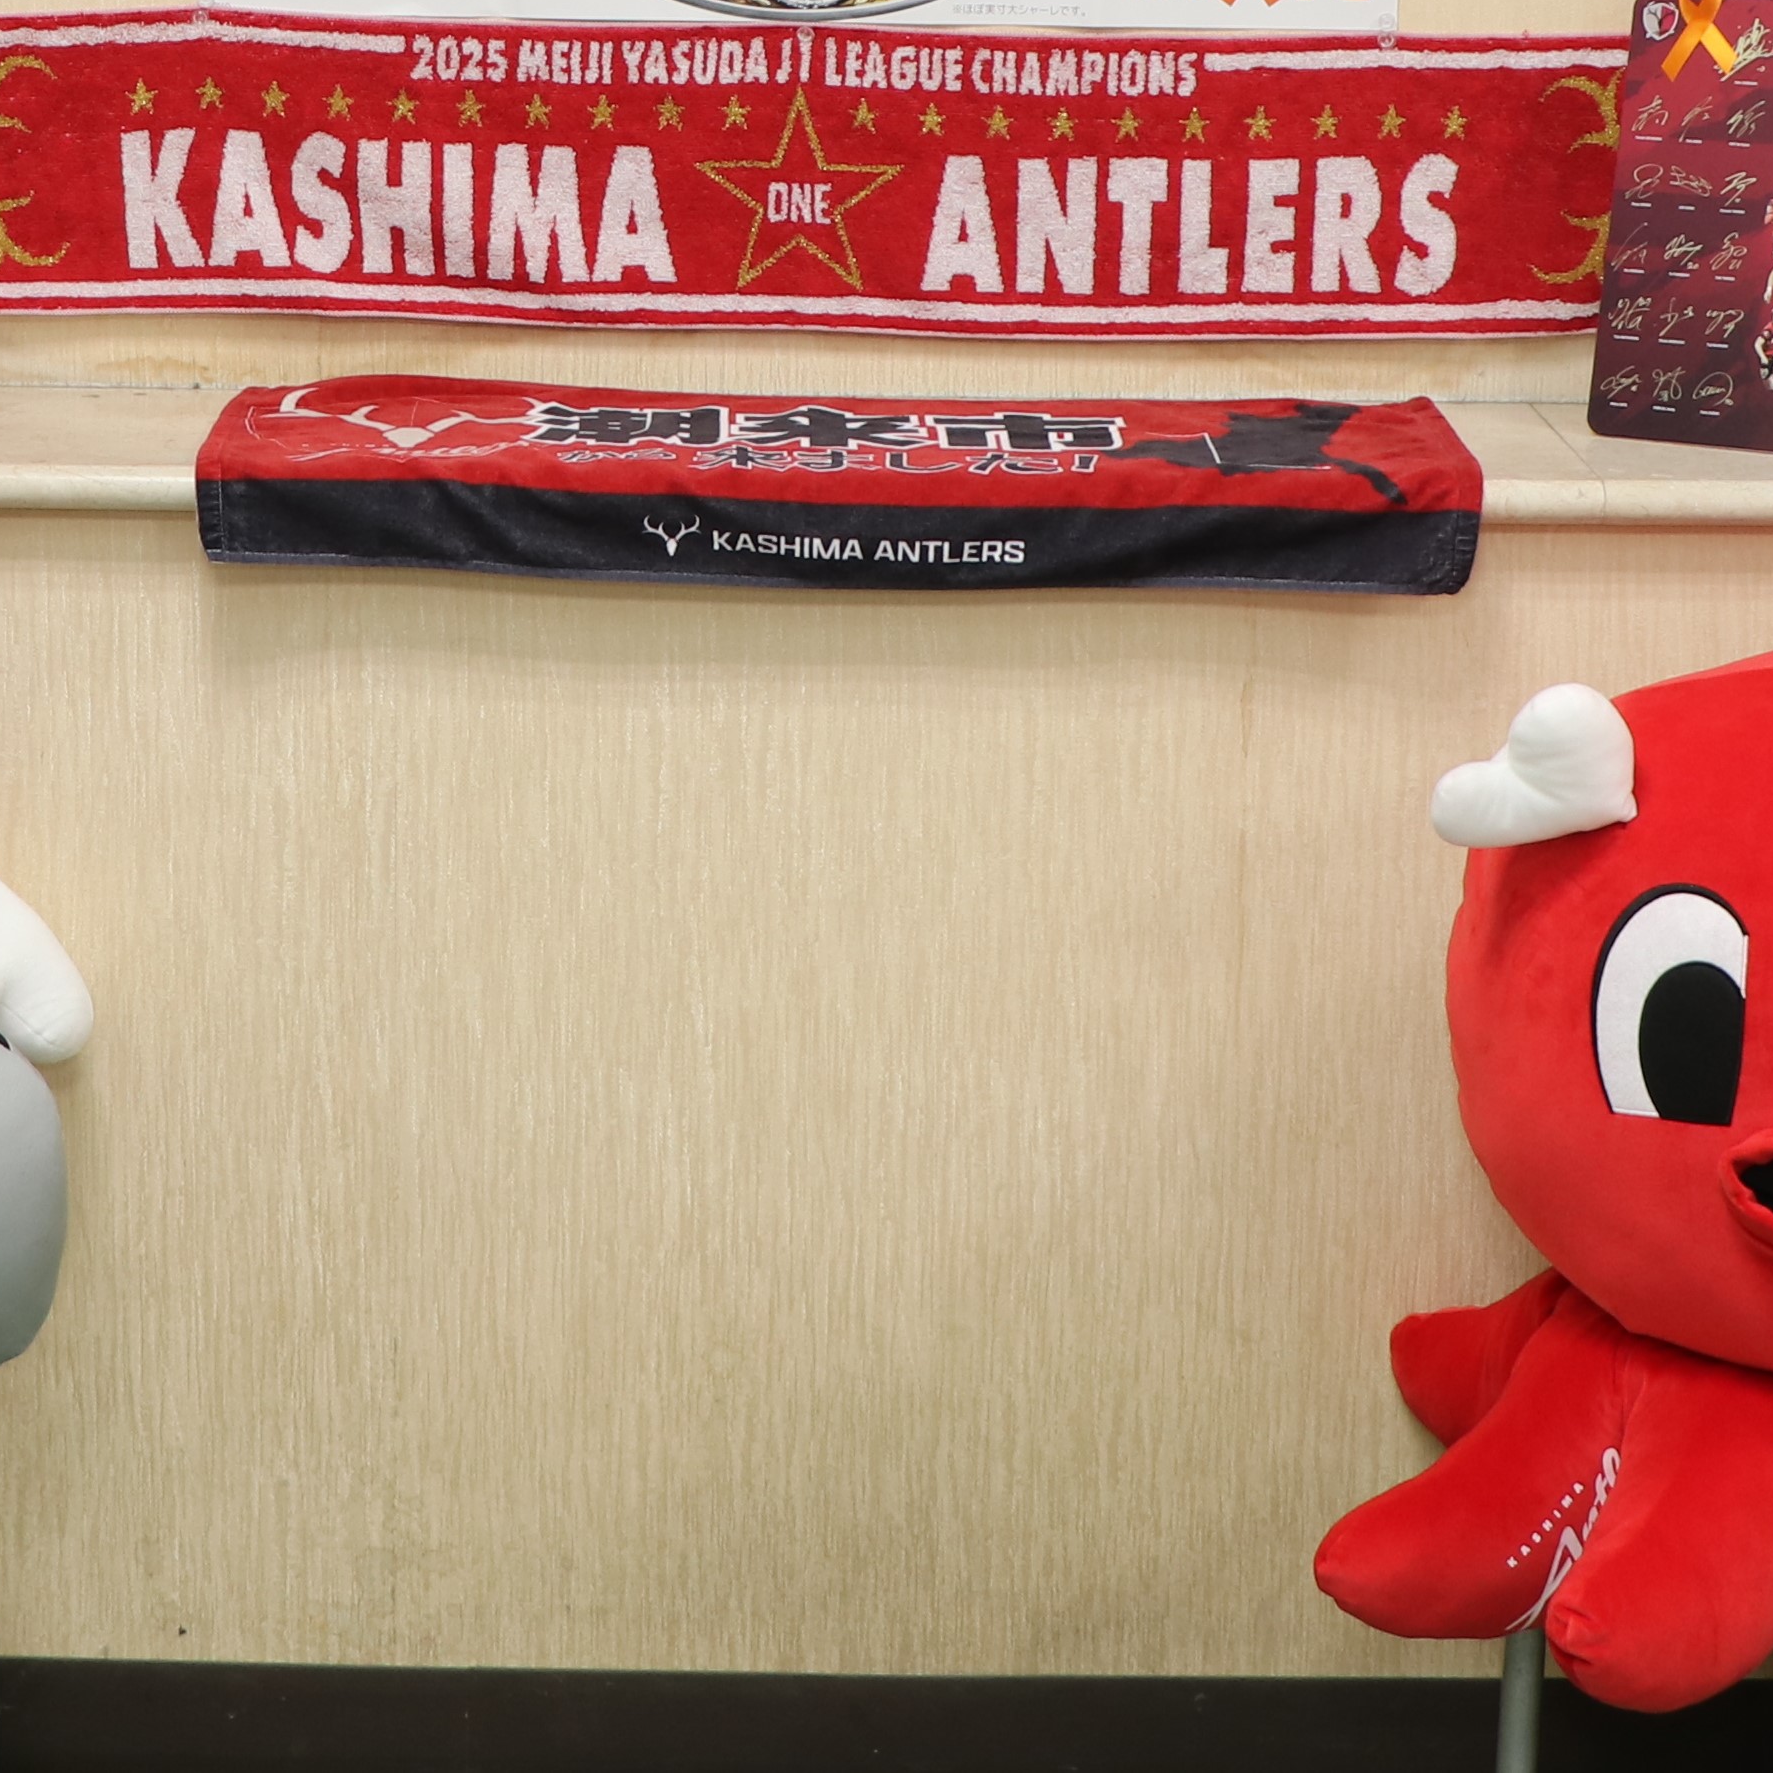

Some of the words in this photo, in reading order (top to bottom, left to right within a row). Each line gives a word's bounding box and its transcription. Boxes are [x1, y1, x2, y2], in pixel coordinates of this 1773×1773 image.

[410, 34, 510, 82] 2025
[516, 40, 614, 84] MEIJI
[622, 36, 769, 85] YASUDA
[825, 40, 963, 93] LEAGUE
[973, 44, 1200, 98] CHAMPIONS
[120, 128, 678, 283] KASHIMA
[767, 182, 832, 227] ONE
[920, 154, 1459, 297] ANTLERS
[712, 529, 864, 562] KASHIMA
[874, 539, 1026, 564] ANTLERS
